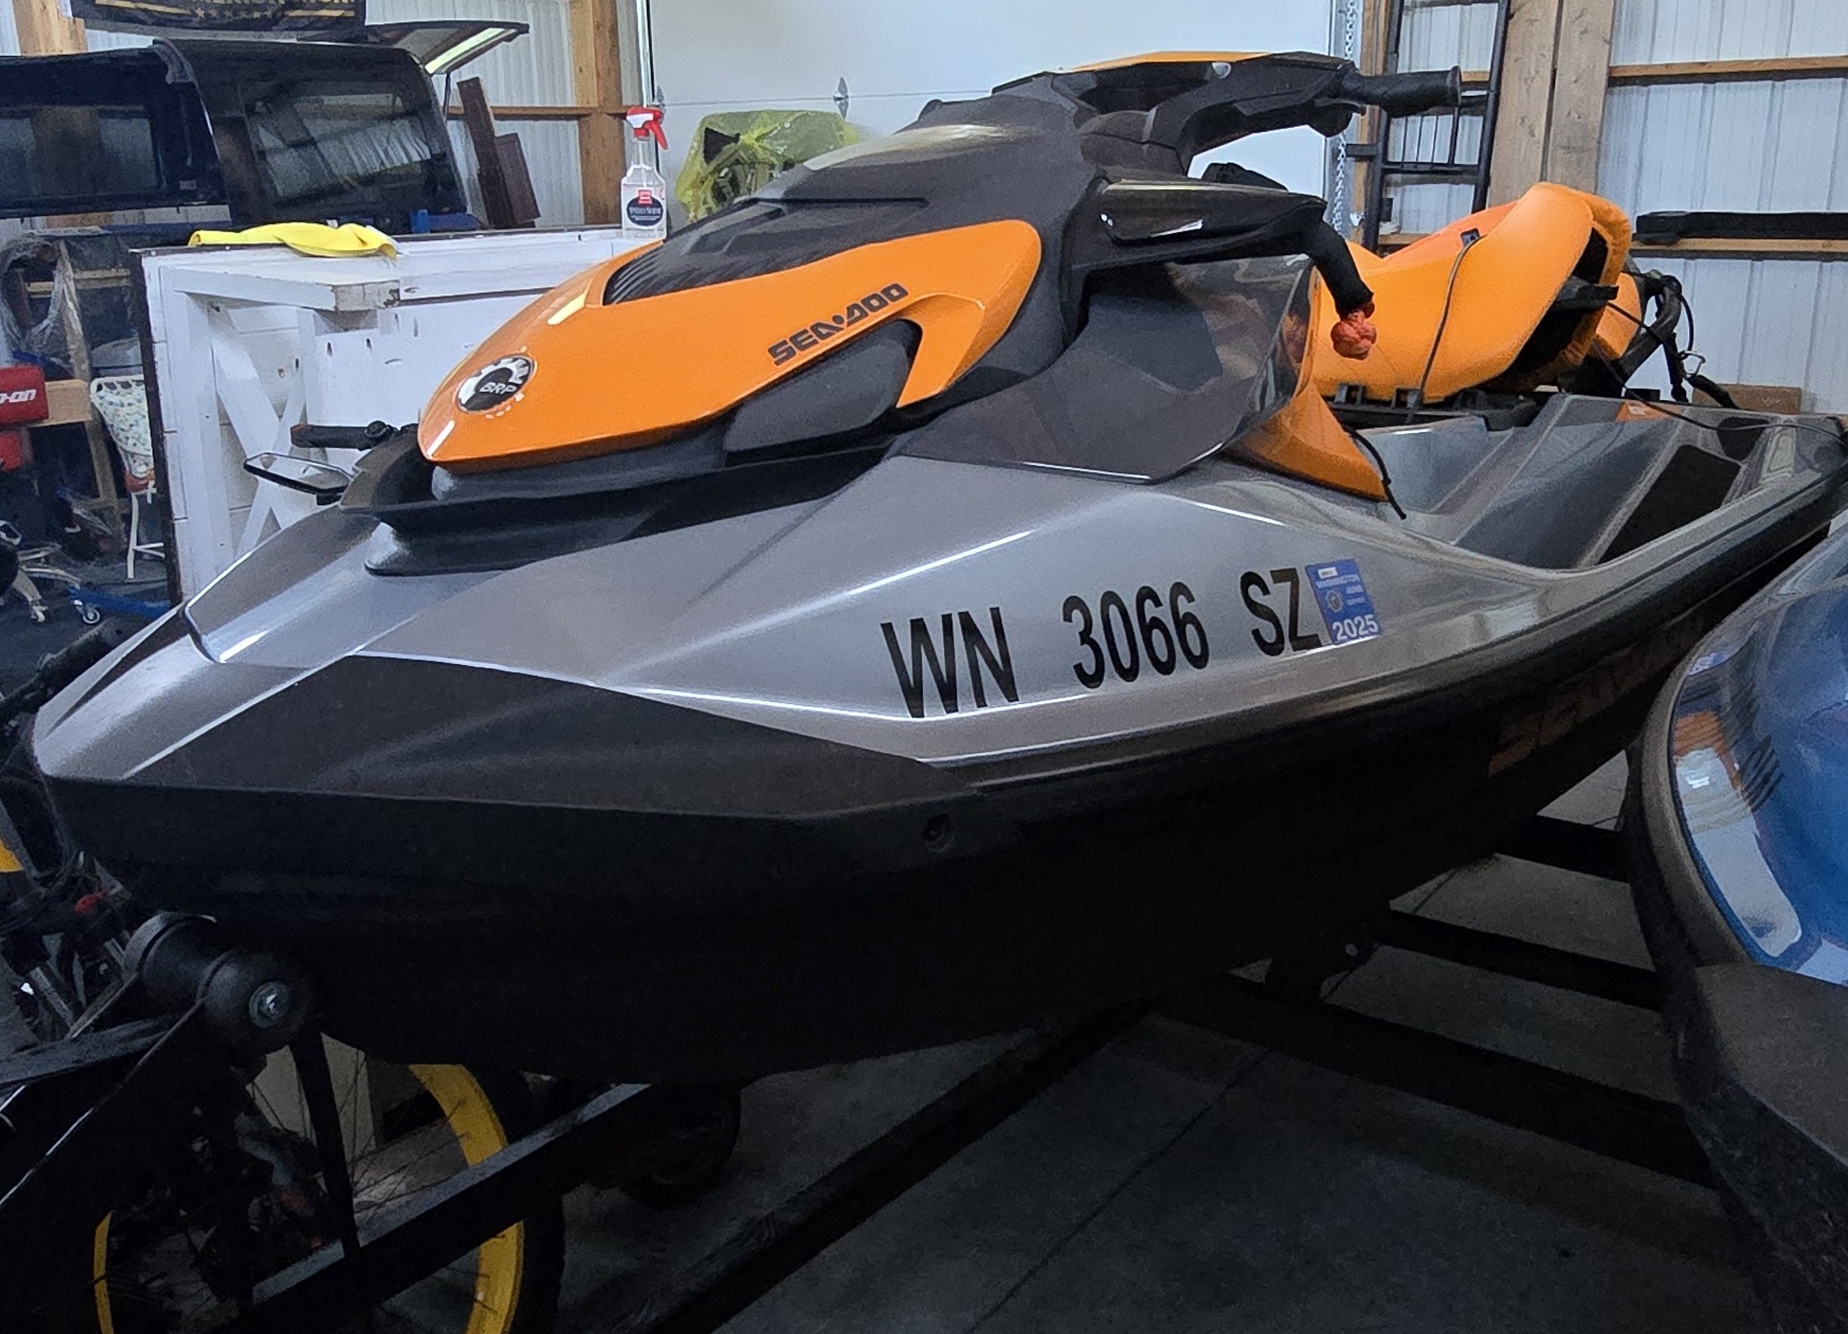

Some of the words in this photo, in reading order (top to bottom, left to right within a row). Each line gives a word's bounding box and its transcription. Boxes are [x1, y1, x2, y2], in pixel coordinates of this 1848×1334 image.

[479, 381, 518, 395] BRP
[1332, 614, 1379, 641] 2025
[880, 606, 1019, 719] WN
[1062, 581, 1210, 689] 3066
[1240, 567, 1322, 657] SZ
